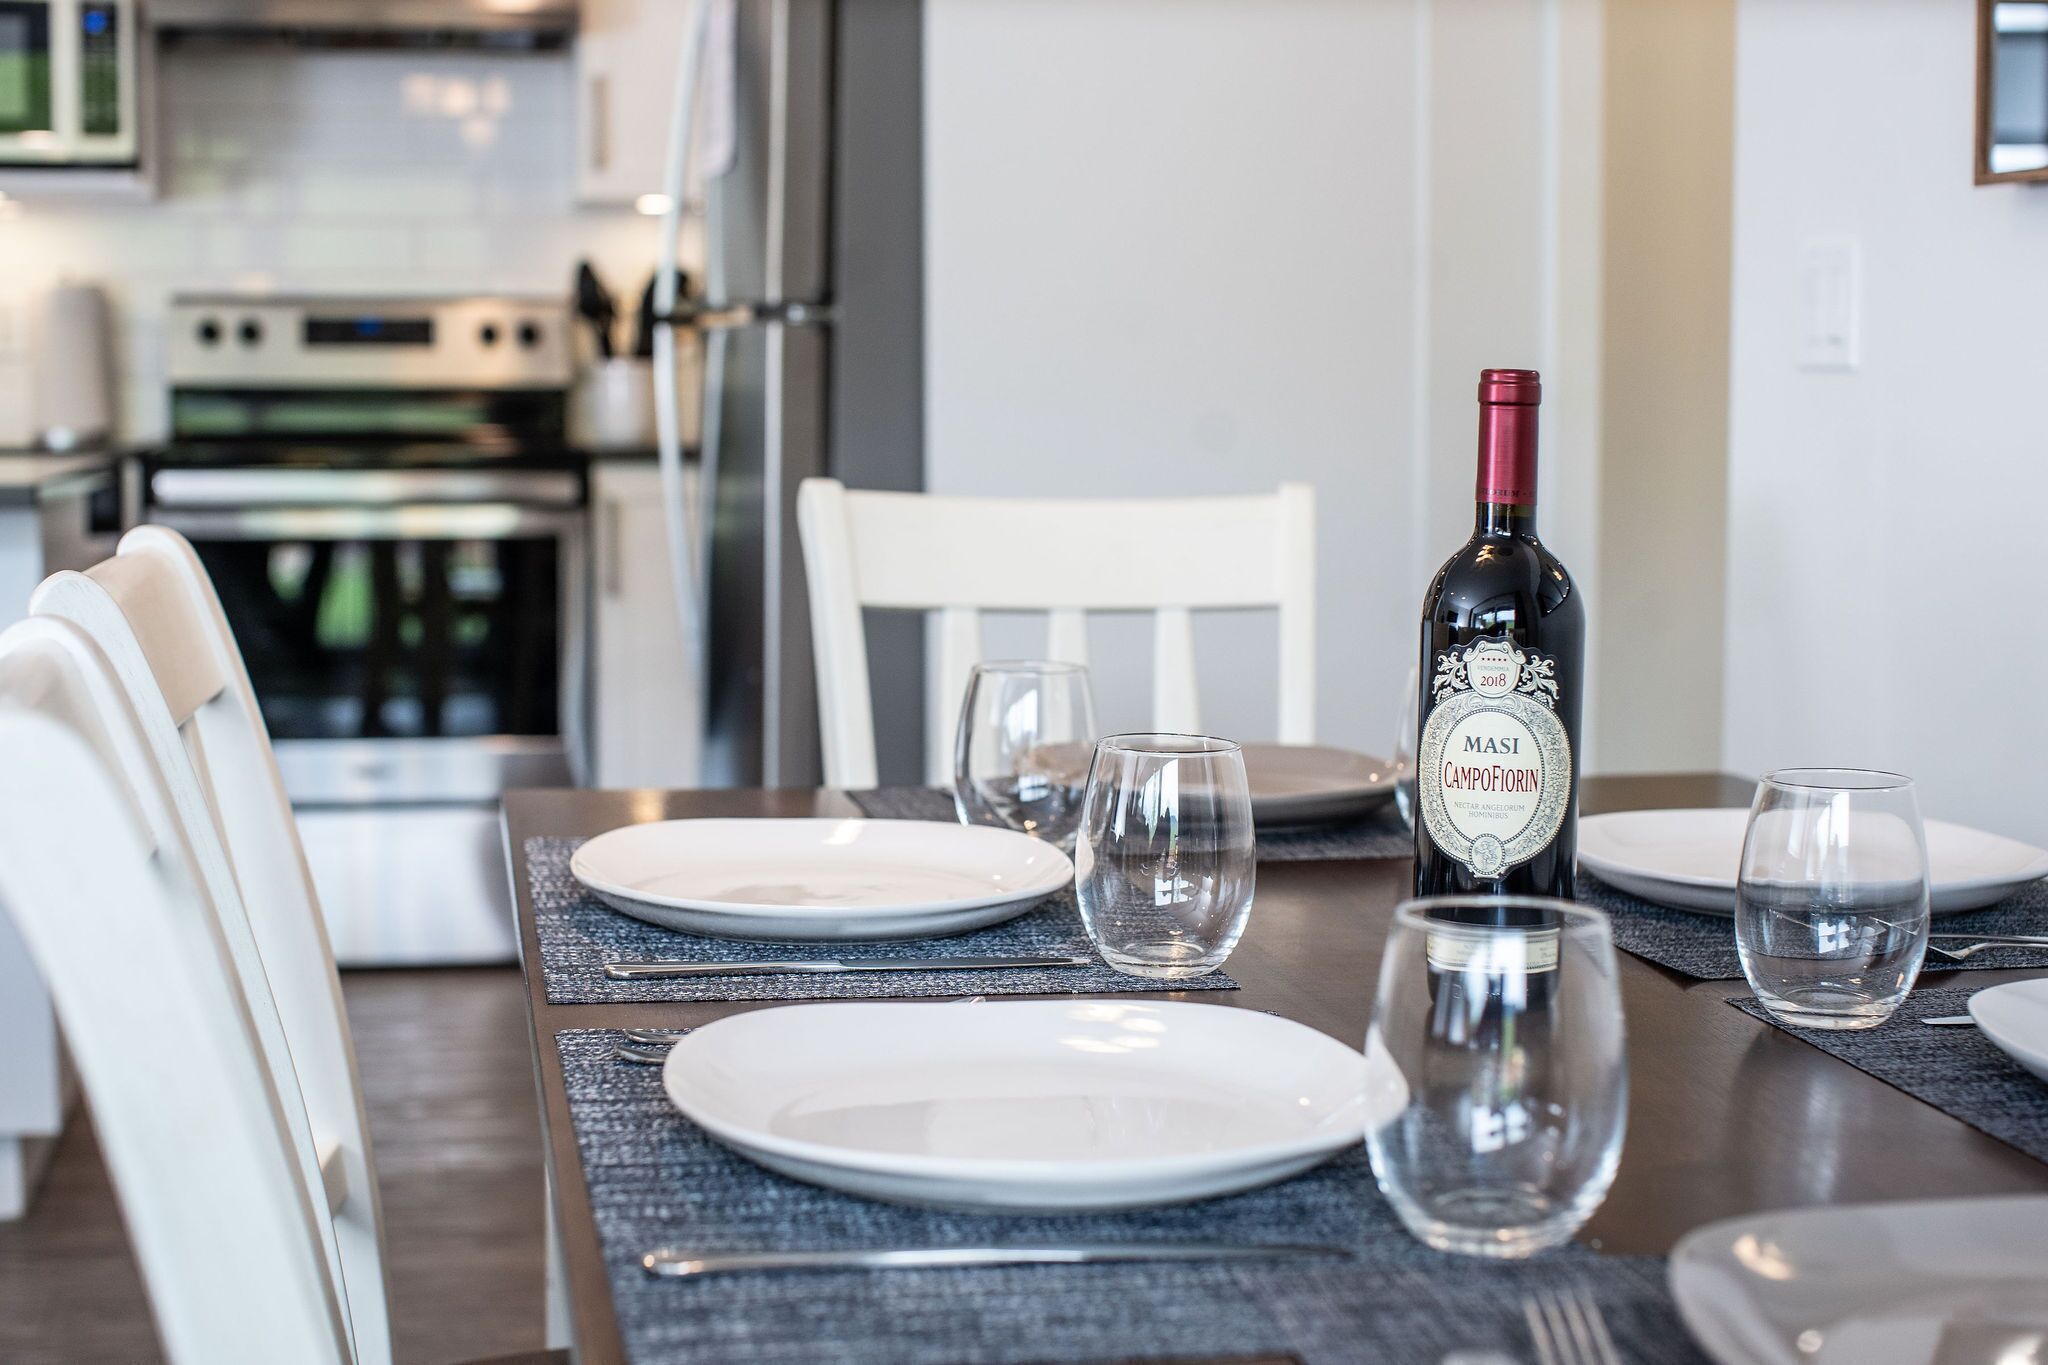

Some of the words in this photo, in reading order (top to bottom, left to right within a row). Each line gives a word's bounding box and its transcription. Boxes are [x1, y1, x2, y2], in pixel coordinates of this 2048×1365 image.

[1480, 673, 1507, 687] 2018
[1463, 735, 1520, 755] MASI
[1454, 801, 1480, 811] NECTAR
[1481, 803, 1525, 812] ANGELORUM
